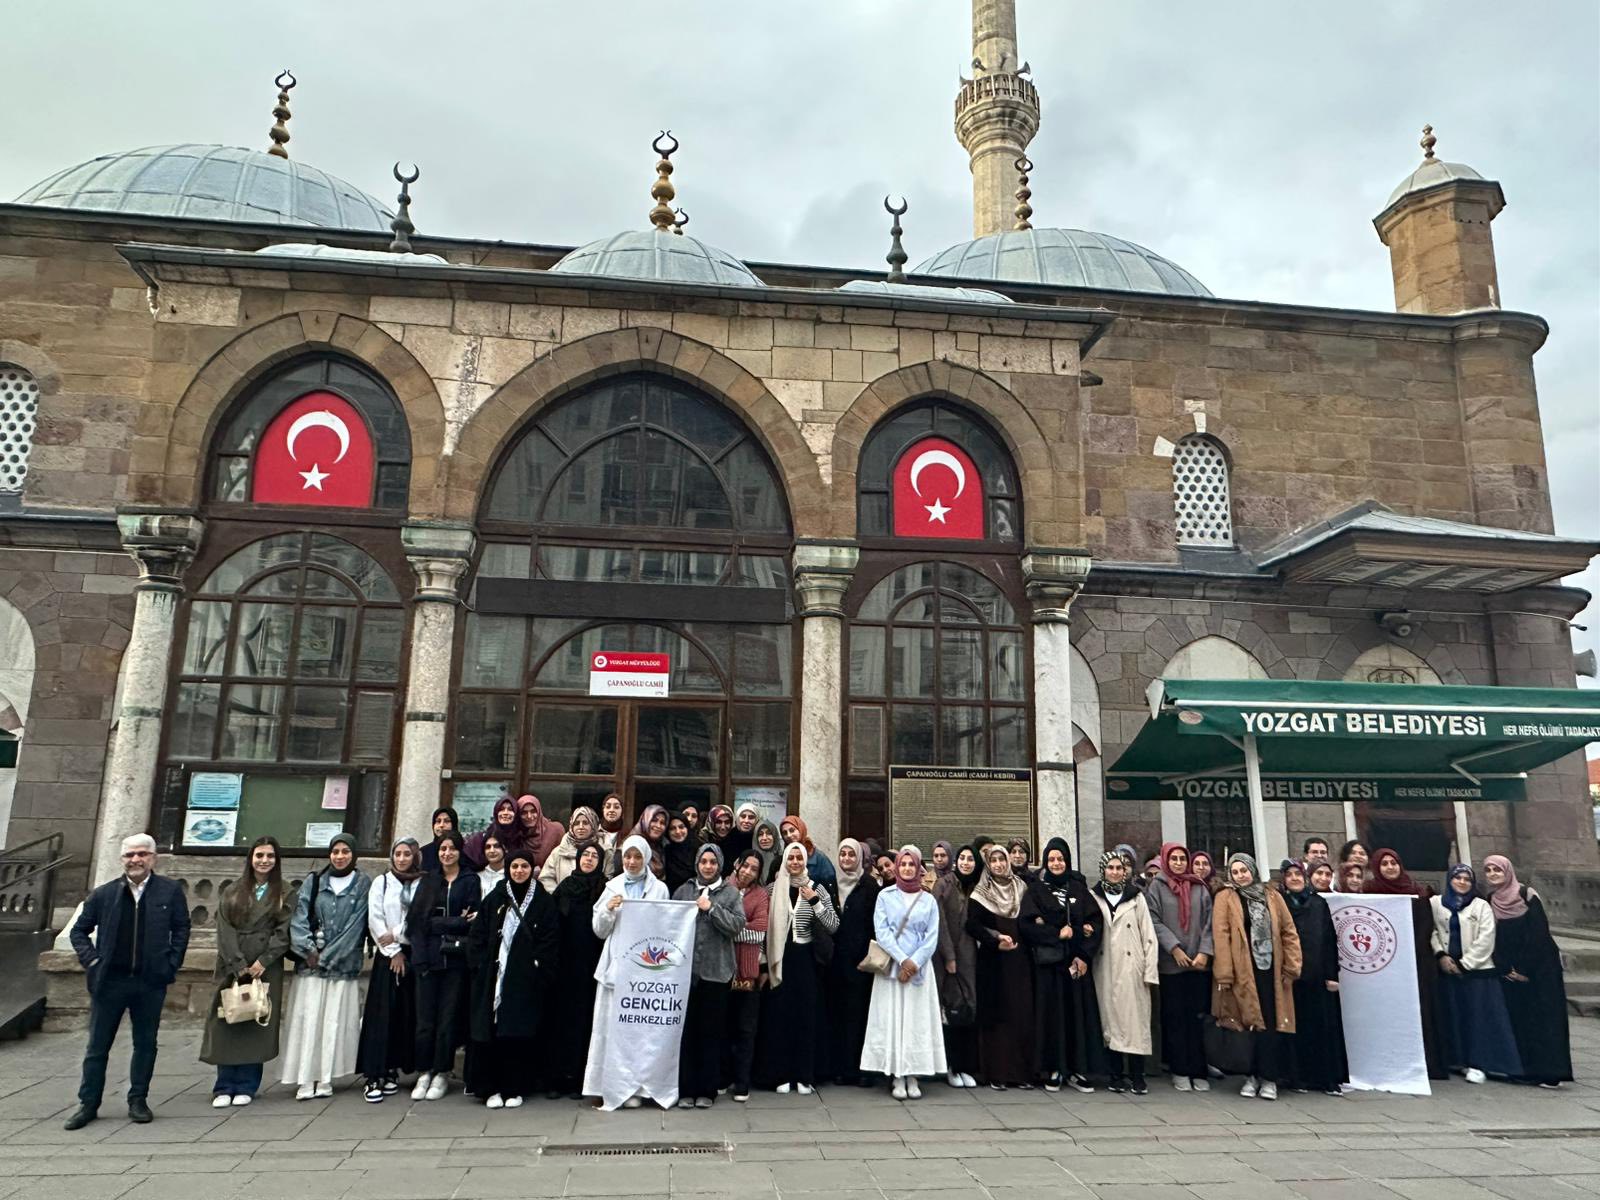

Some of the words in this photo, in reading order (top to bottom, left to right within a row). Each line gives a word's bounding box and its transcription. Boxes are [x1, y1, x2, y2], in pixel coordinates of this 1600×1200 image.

[1240, 712, 1338, 733] YOZGAT
[1502, 724, 1518, 736] HER
[905, 770, 947, 778] ÇAPANOĞLU
[948, 771, 968, 779] CAMİİ
[629, 981, 679, 995] YOZGAT
[620, 997, 682, 1012] GENÇLİK
[618, 1014, 681, 1026] MERKEZLERİ
